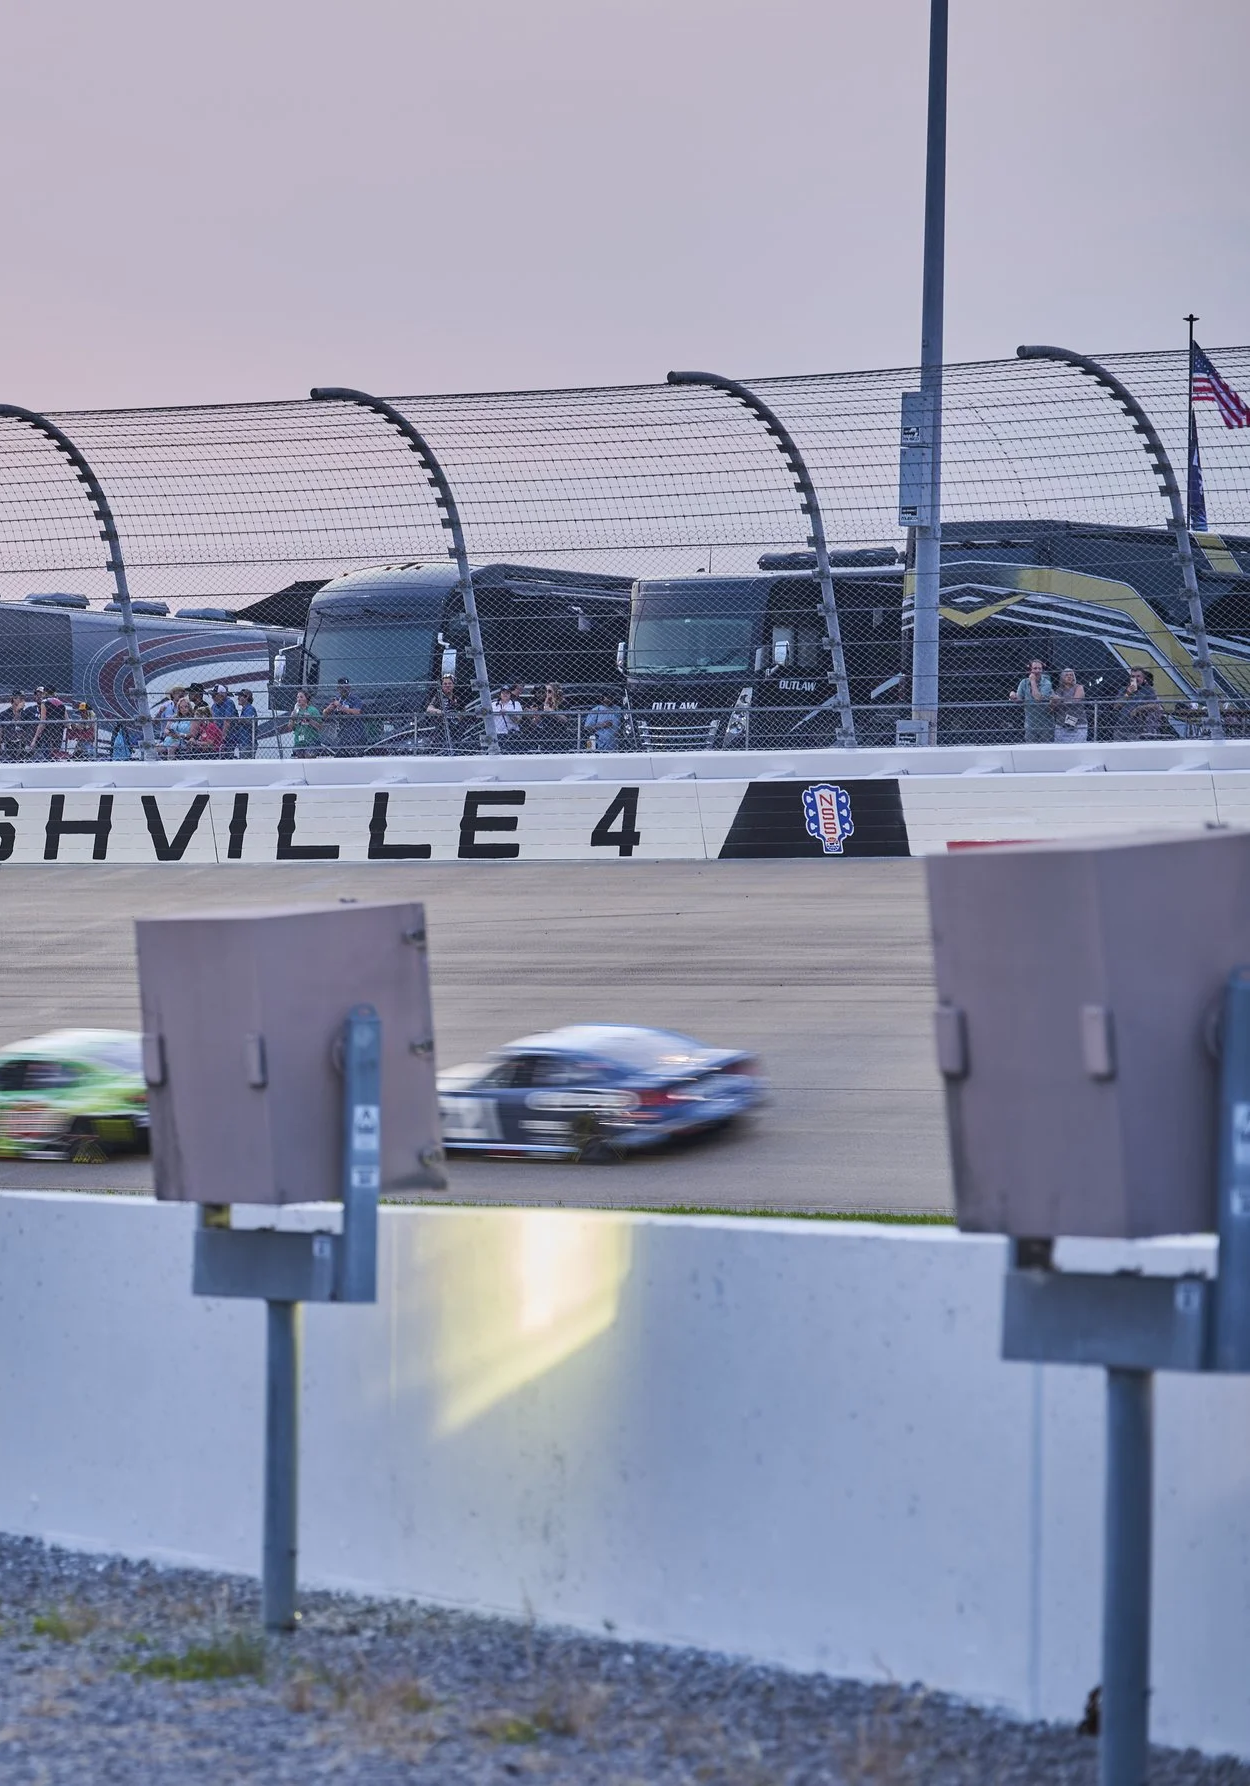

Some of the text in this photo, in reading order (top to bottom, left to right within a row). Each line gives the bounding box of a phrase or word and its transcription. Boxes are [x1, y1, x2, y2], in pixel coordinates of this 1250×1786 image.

[779, 680, 816, 691] OUTLAW
[652, 702, 698, 711] OUTLAW
[590, 787, 641, 857] 4
[819, 793, 837, 835] NSS
